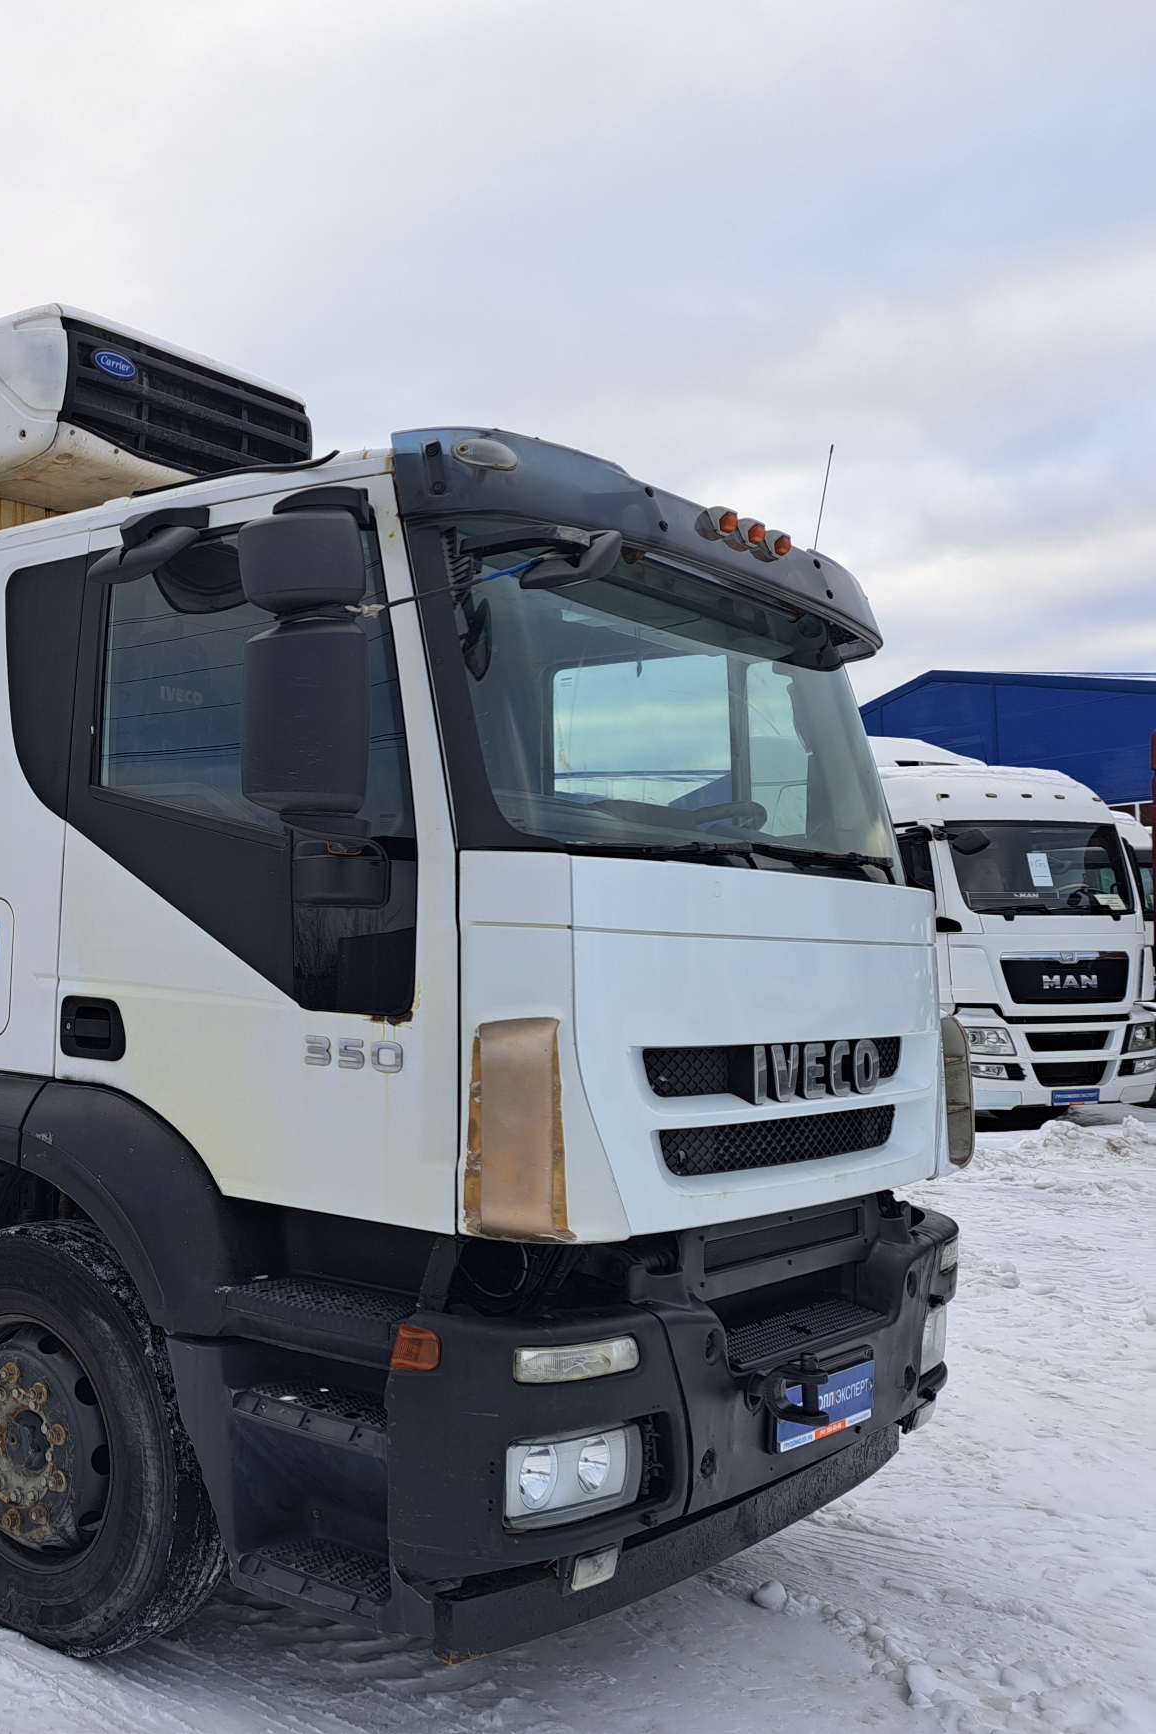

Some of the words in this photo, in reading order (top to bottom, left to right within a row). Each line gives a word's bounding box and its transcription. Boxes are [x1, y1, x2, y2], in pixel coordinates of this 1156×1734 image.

[100, 355, 131, 372] Carrier
[160, 685, 203, 705] IVECO
[1042, 974, 1099, 989] MAN
[304, 1034, 404, 1074] 350
[753, 1039, 880, 1106] IVECO
